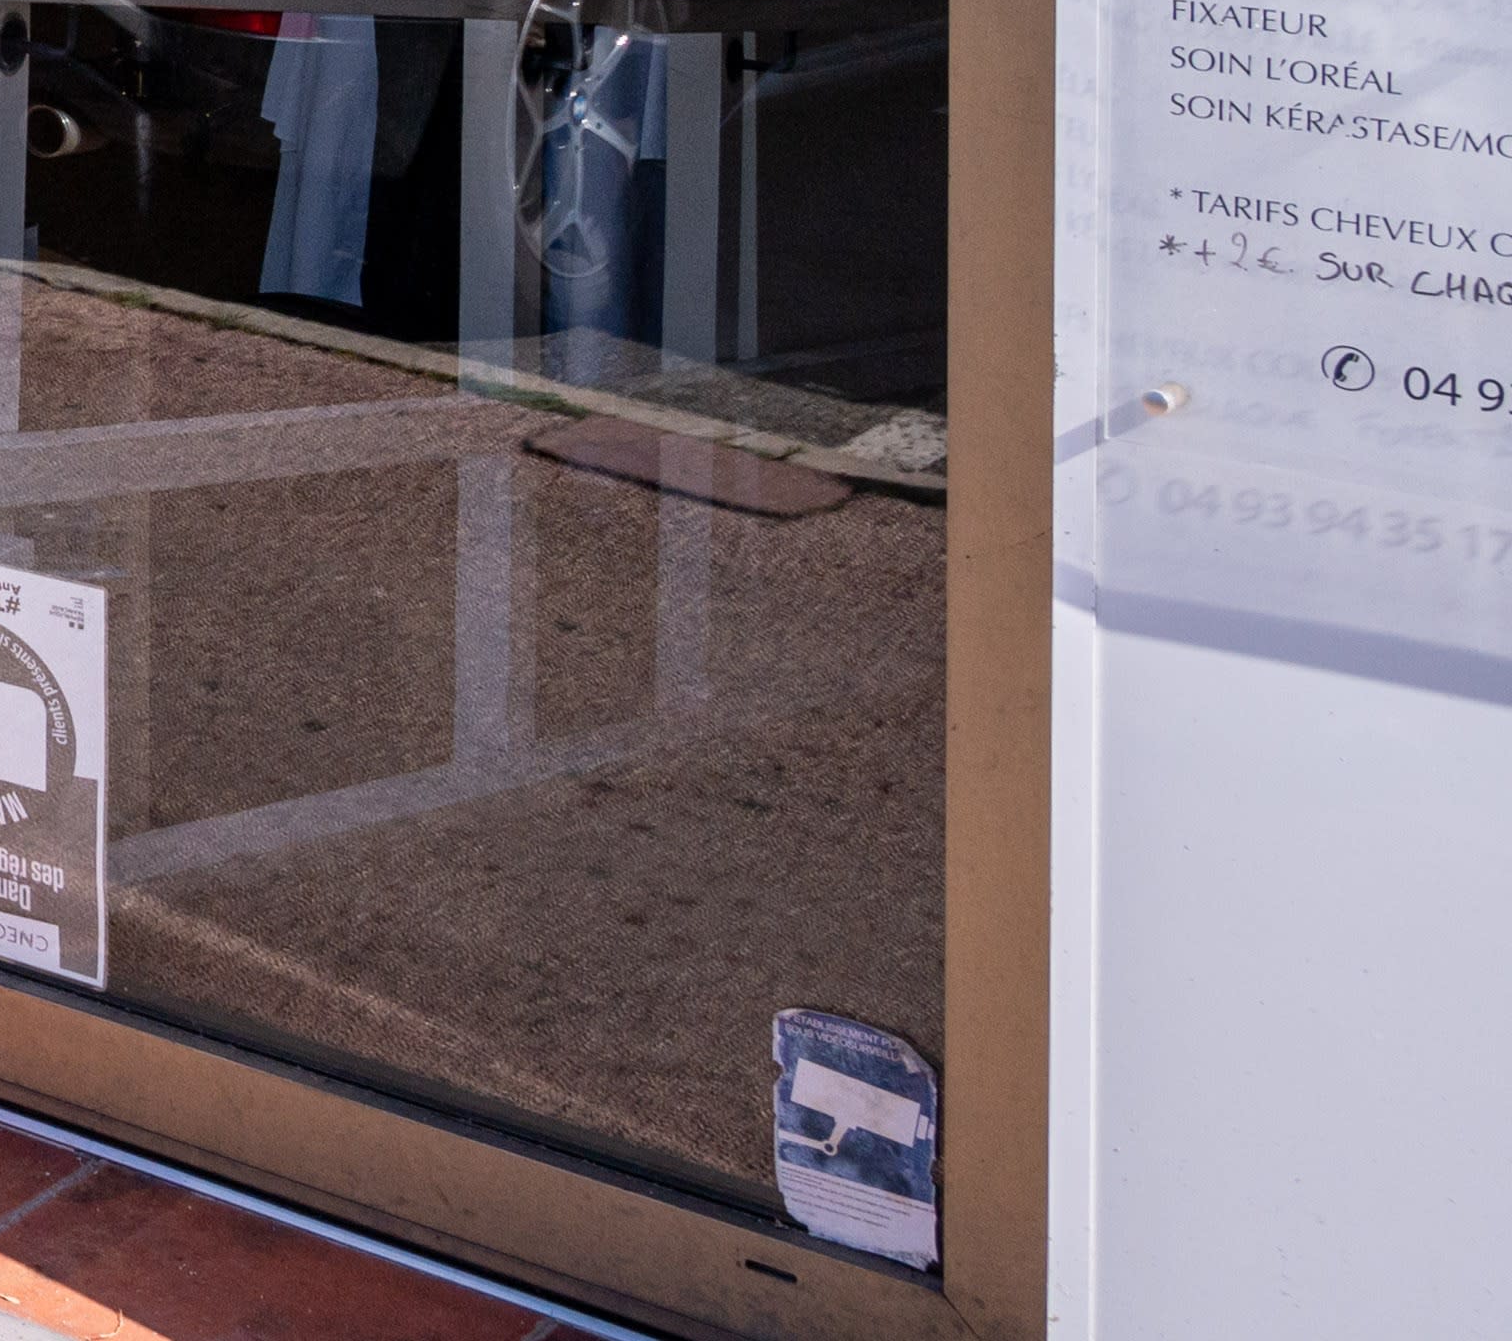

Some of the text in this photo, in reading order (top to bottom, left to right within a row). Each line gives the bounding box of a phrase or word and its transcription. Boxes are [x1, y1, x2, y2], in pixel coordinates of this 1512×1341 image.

[1170, 45, 1403, 96] SOIN L'ORÉAL
[1170, 93, 1252, 125] SOIN
[1191, 189, 1300, 227] TARIFS
[1311, 207, 1478, 253] CHEVEUX
[1316, 252, 1394, 289] SUR
[1403, 366, 1512, 414] 04 9
[9, 641, 58, 697] présents
[49, 698, 68, 746] clients
[31, 860, 64, 894] des
